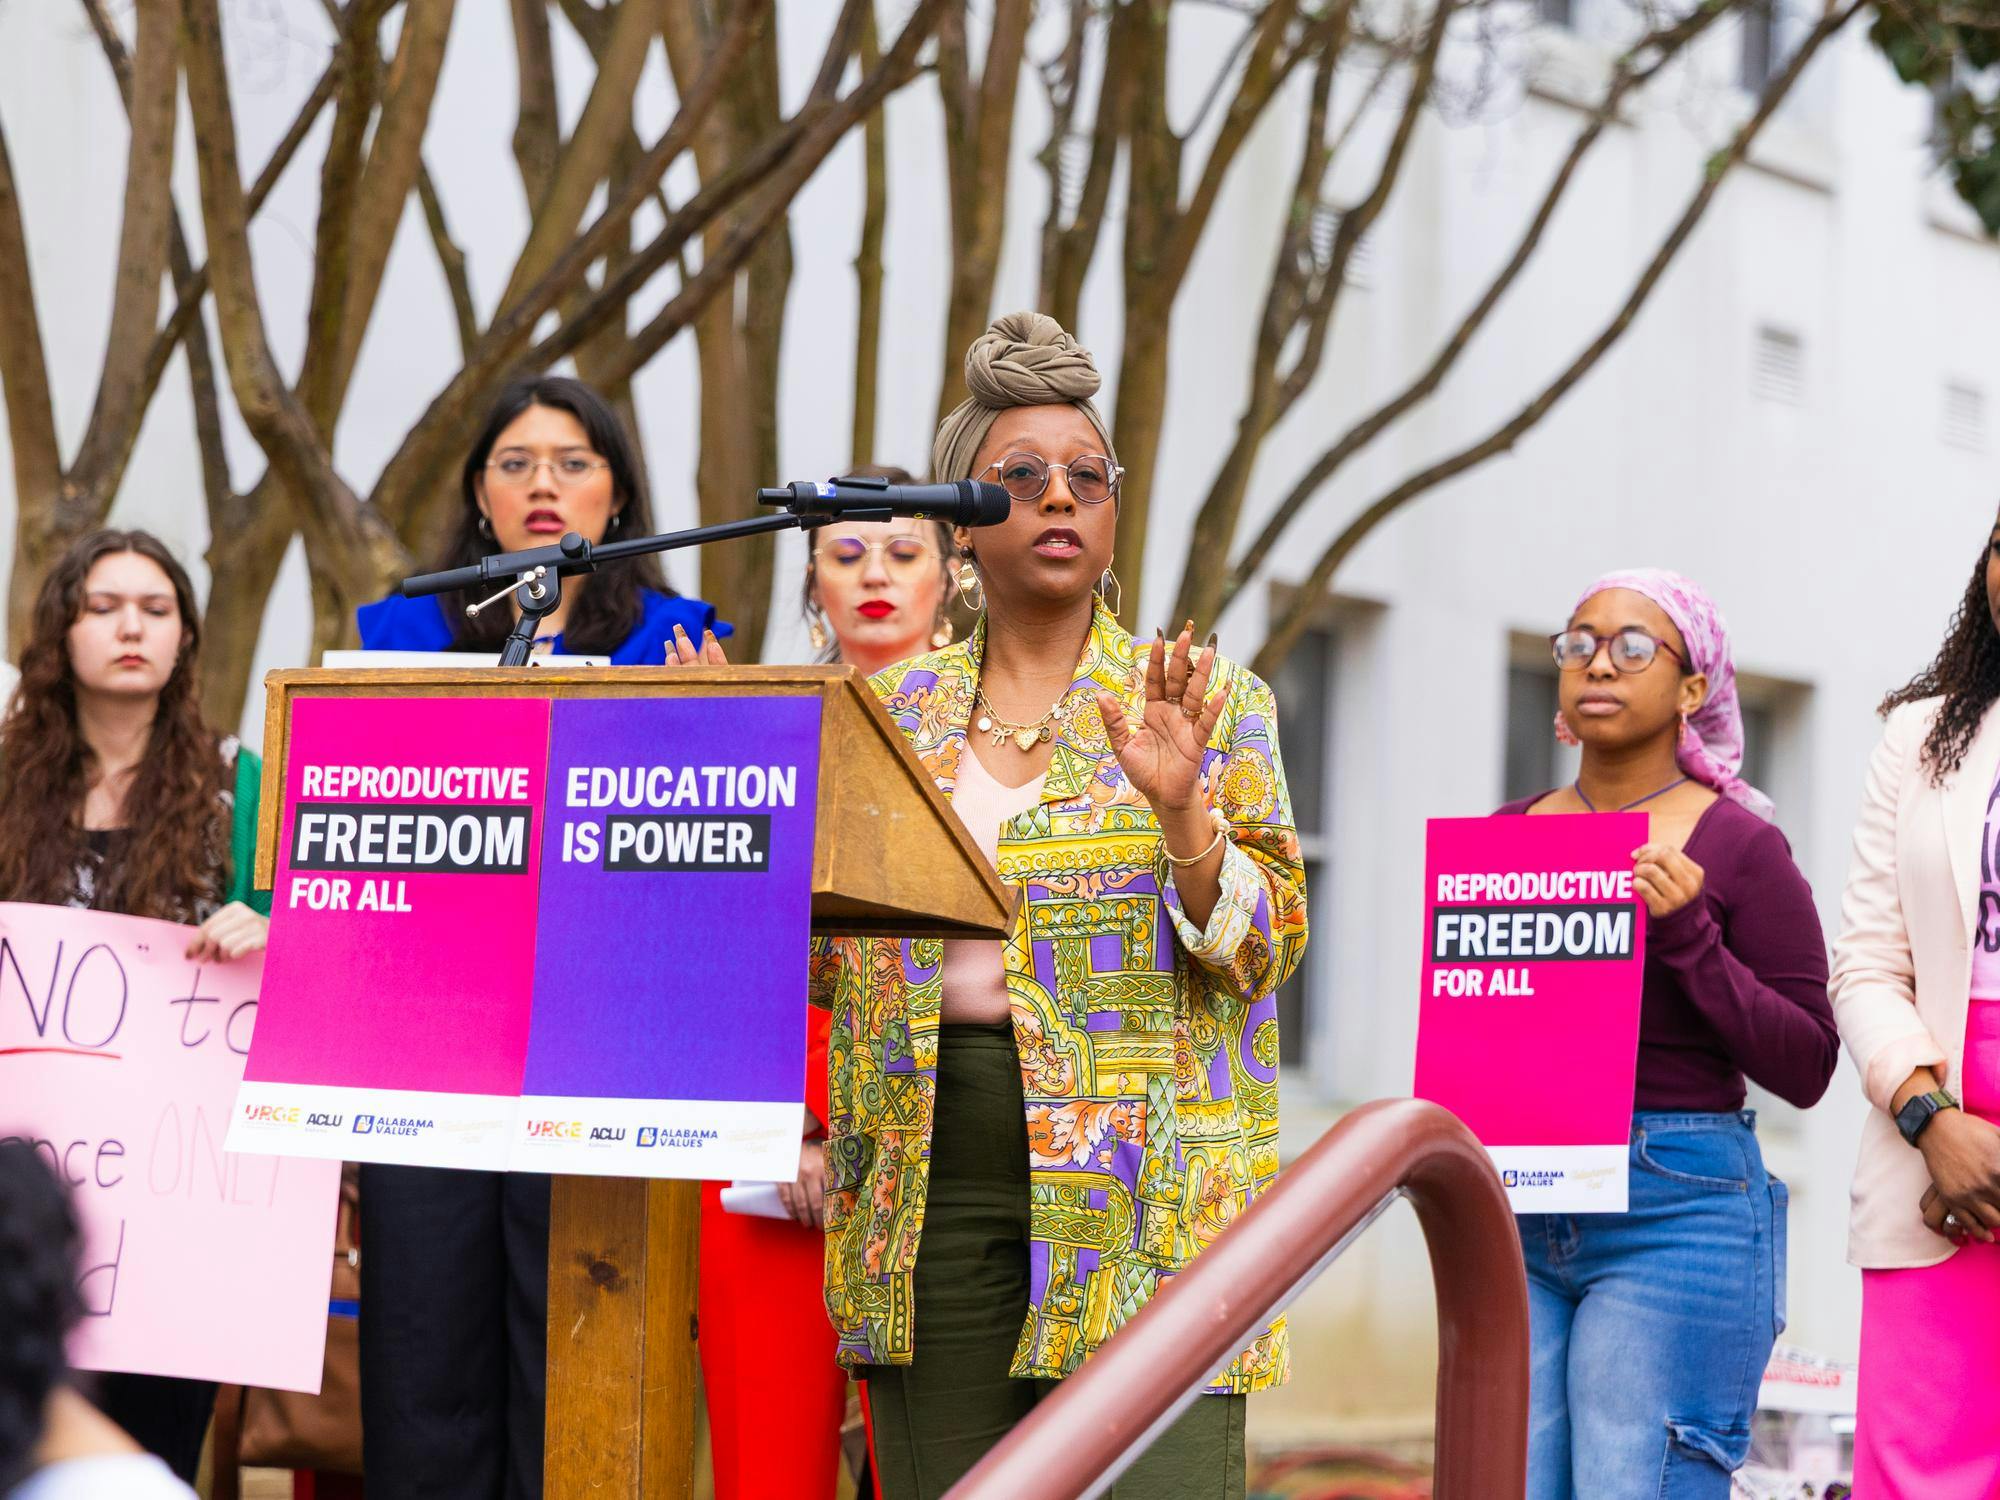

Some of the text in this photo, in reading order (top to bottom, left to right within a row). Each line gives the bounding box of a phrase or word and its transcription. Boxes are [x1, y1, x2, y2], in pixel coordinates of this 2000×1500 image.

[302, 765, 529, 800] REPRODUCTIVE
[566, 766, 797, 807] EDUCATION
[296, 813, 526, 866] FREEDOM
[563, 822, 763, 863] IS POWER.
[290, 878, 412, 913] FOR ALL
[1437, 870, 1633, 902] REPRODUCTIVE
[1436, 911, 1631, 957] FREEDOM
[1433, 968, 1535, 998] FOR ALL
[245, 1104, 301, 1123] URGE
[306, 1113, 343, 1127] ACLU
[377, 1117, 434, 1129] ALABAMA
[376, 1126, 419, 1137] VALUES
[528, 1120, 582, 1138] URGE
[590, 1127, 626, 1141] ACLU
[660, 1128, 719, 1140] ALABAMA
[660, 1137, 703, 1149] VALUES
[1520, 1171, 1565, 1179] ALABAMA
